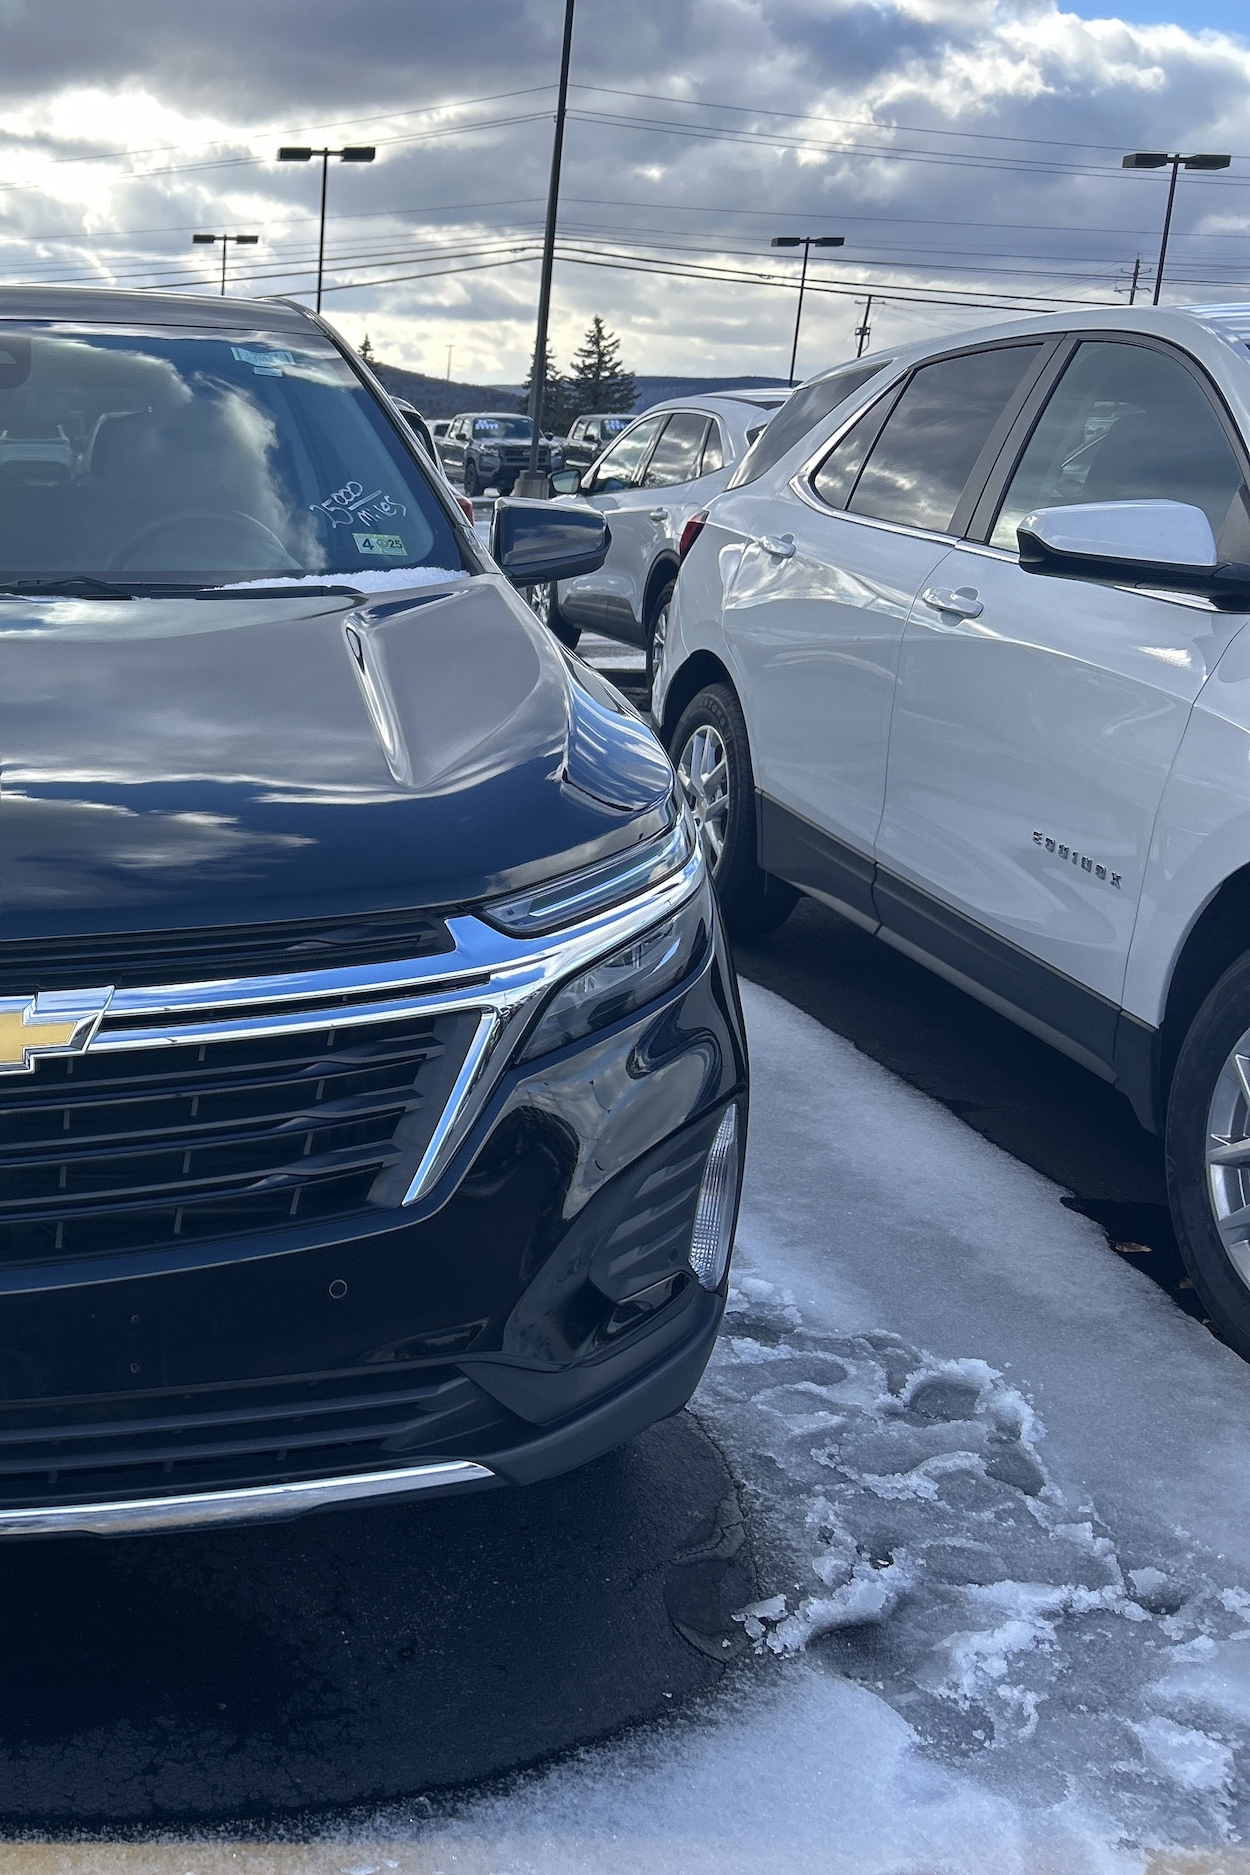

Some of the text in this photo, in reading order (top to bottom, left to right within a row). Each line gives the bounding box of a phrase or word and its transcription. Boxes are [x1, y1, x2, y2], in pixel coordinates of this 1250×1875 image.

[362, 538, 403, 550] 4 25
[1032, 830, 1122, 890] EQUINOX
